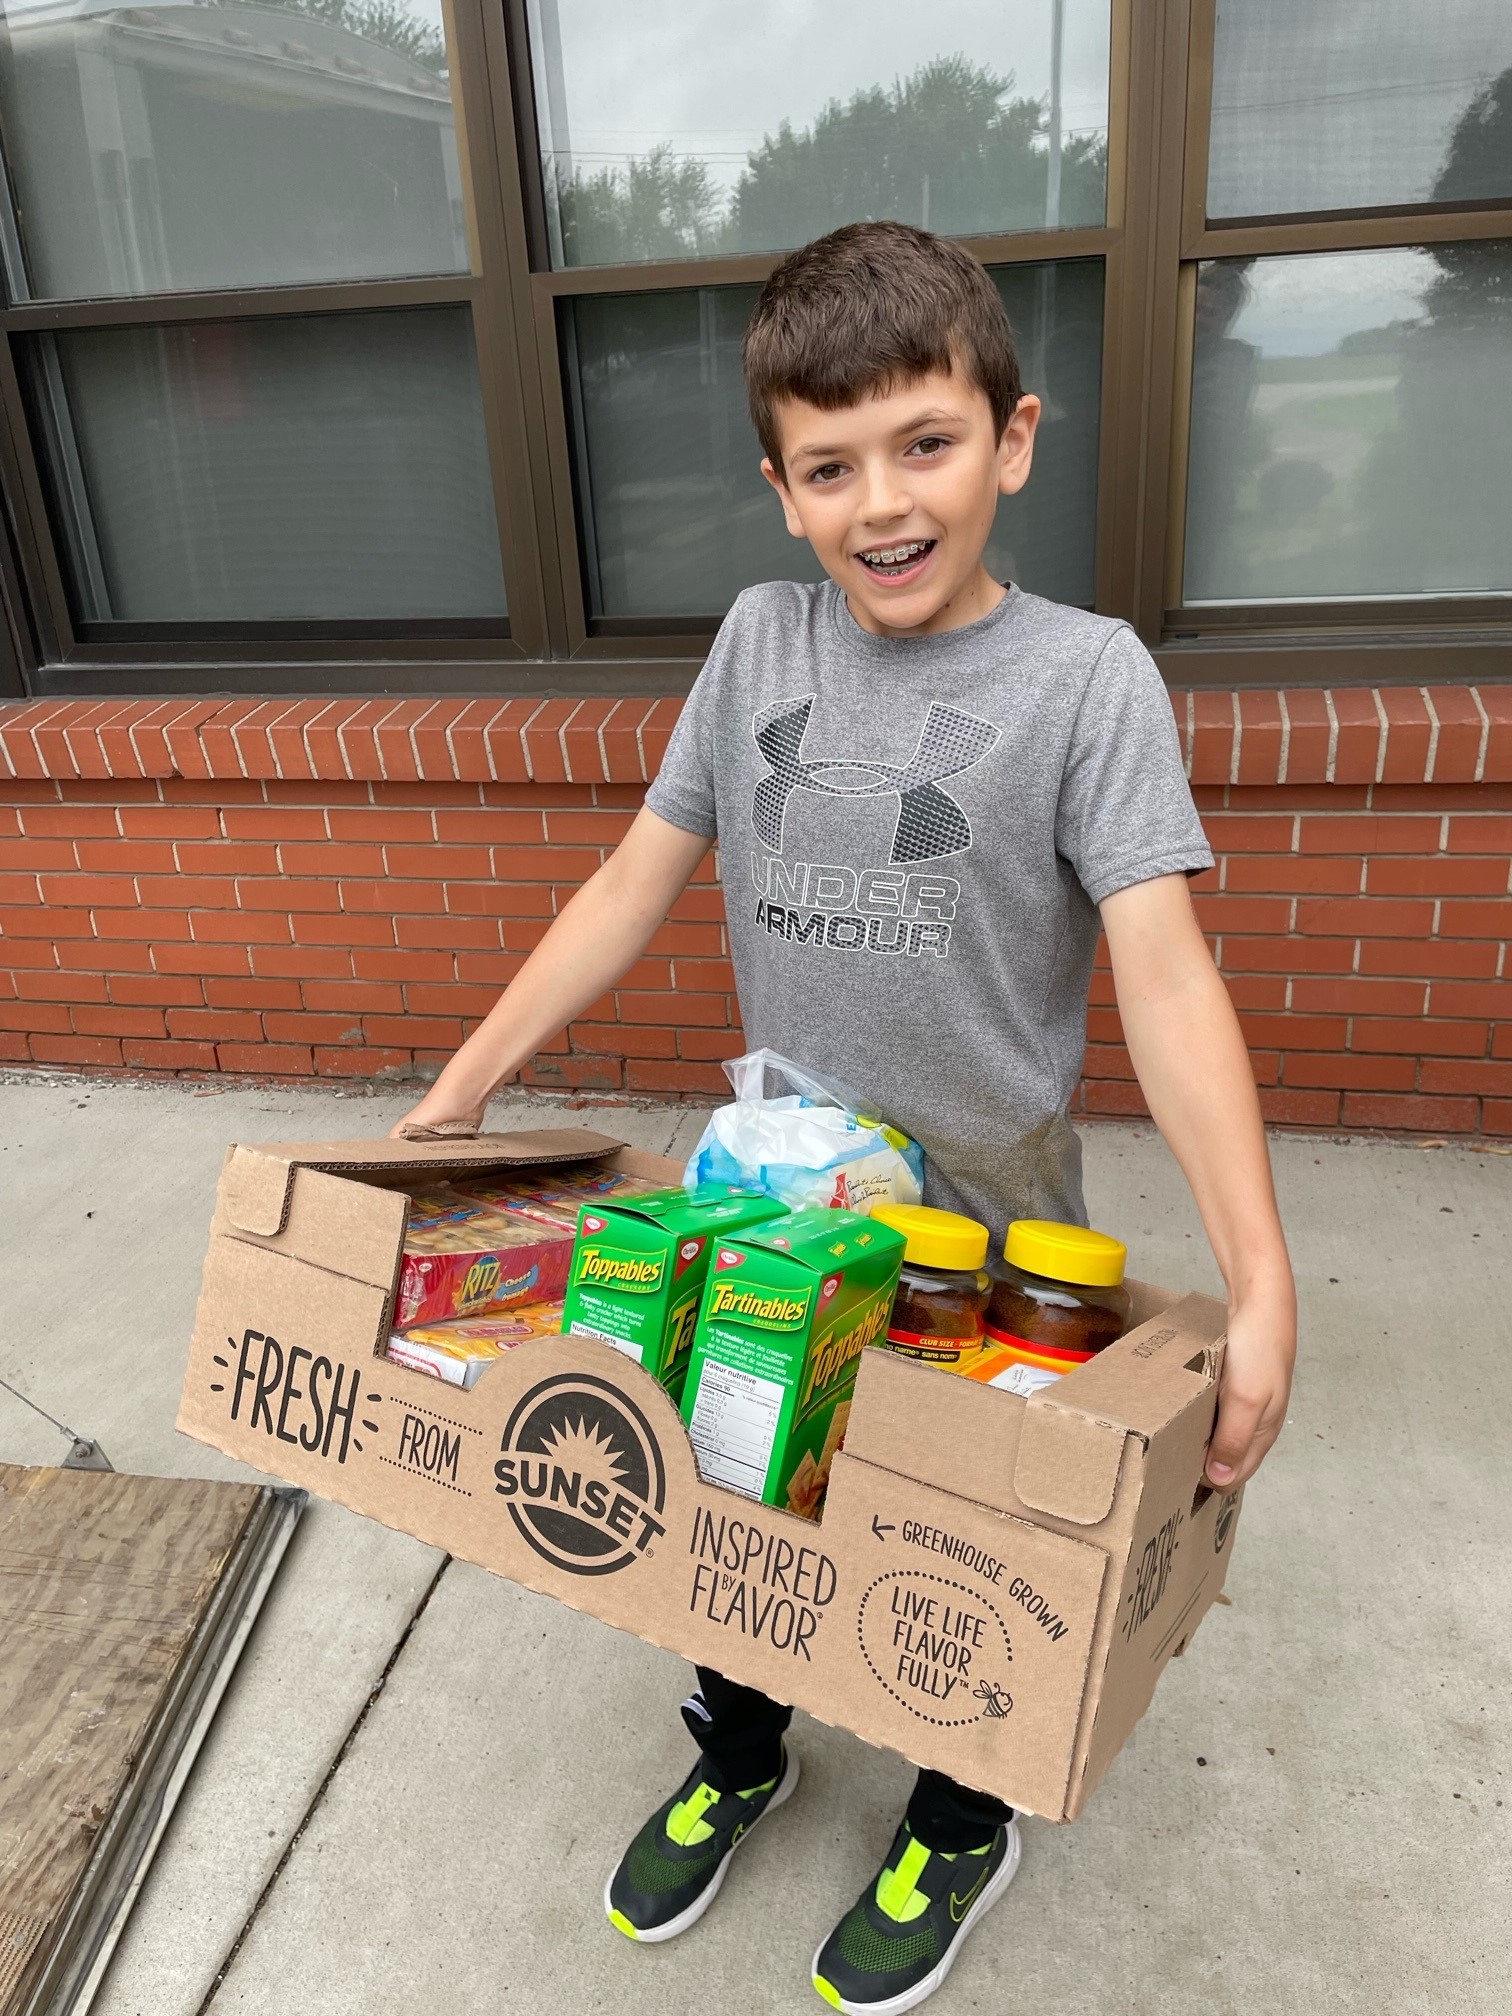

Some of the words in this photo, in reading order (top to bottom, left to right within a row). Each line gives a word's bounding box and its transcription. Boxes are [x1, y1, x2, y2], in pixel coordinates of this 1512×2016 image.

[751, 852, 960, 920] UNDER
[755, 896, 951, 957] ARMOUR
[461, 1261, 501, 1302] RITZ
[505, 1270, 532, 1287] Cheese
[580, 1249, 662, 1283] Toppables
[711, 1284, 807, 1320] Tartinables
[572, 1323, 599, 1338] Nutrition
[600, 1333, 617, 1346] Facts
[801, 1292, 892, 1409] Toppables
[919, 1337, 938, 1346] CLUB
[939, 1339, 955, 1348] SIZE
[921, 1350, 939, 1360] sans
[702, 1376, 723, 1389] Calories
[724, 1384, 731, 1392] 90
[705, 1360, 727, 1374] Valeur
[727, 1369, 757, 1385] nutritive
[231, 1329, 361, 1464] FRESH
[398, 1414, 462, 1482] FROM
[690, 1506, 838, 1607] INSPIRED
[721, 1574, 736, 1592] BY
[902, 1519, 1008, 1586] GREENHOUSE
[1008, 1576, 1069, 1643] GROWN
[891, 1585, 937, 1628] LIVE
[942, 1606, 988, 1649] LIFE
[893, 1619, 972, 1677] FLAVOR
